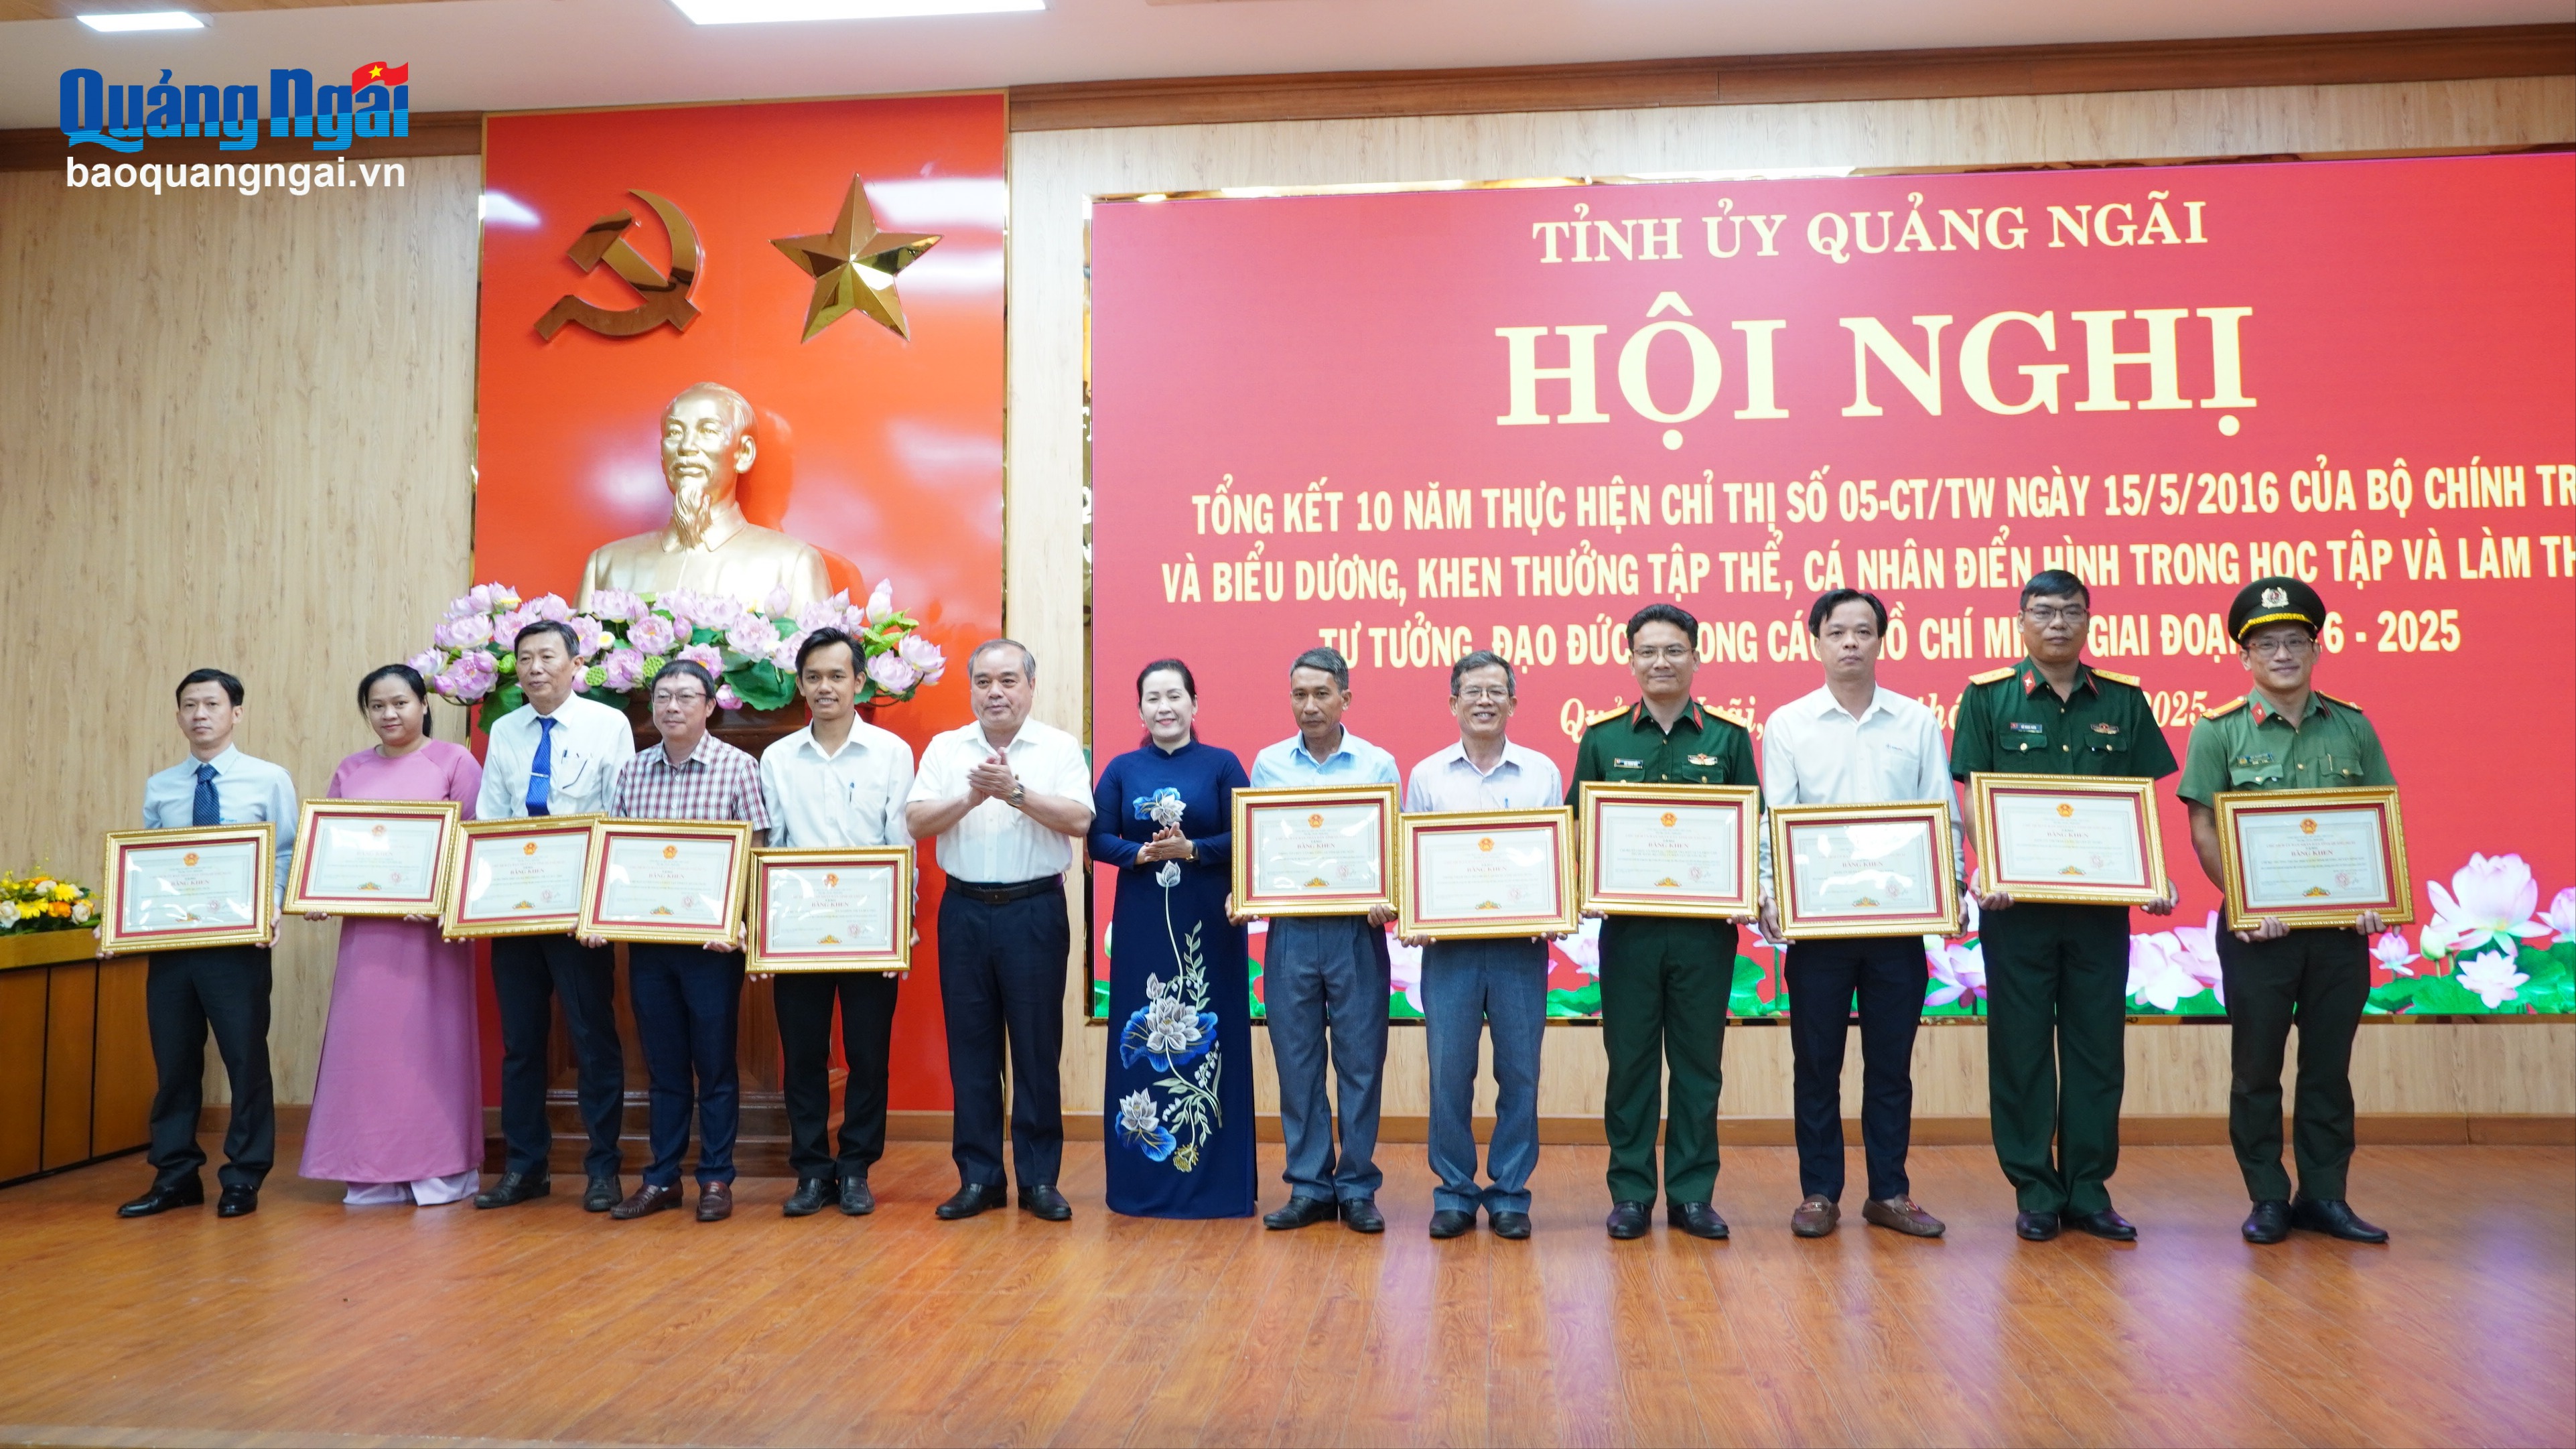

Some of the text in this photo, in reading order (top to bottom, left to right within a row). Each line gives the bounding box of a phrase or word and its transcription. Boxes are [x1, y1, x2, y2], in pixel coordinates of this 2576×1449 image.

[1532, 190, 2208, 264] TỈNH ỦY QUẢNG NGÃI
[1495, 291, 2257, 451] HỘI NGHỊ
[1191, 473, 1274, 535] TỔNG
[1284, 476, 1344, 533] KẾT
[1357, 490, 1393, 532] 10
[1404, 481, 1472, 531] NĂM
[1481, 480, 1566, 536] THỰC
[1576, 475, 1651, 535] HIỆN
[1661, 469, 1714, 526] CHỈ
[1722, 482, 1776, 533] THỊ
[1786, 465, 1830, 523] SỐ
[1838, 477, 1995, 522] 05-CT/TW
[2007, 465, 2090, 518] NGÀY
[2104, 471, 2279, 516] 15/5/2016
[2290, 454, 2357, 512] CỦA
[2366, 458, 2413, 518] BỘ
[2425, 456, 2526, 510] CHÍNH
[1161, 552, 1201, 603] VÀ
[1213, 540, 1284, 602] BIỂU
[1295, 553, 1407, 607] DƯƠNG,
[1418, 557, 1502, 598] KHEN
[1511, 539, 1639, 597] THƯỞNG
[1647, 542, 1710, 602] TẬP
[1718, 529, 1793, 600] THỂ,
[1804, 539, 1846, 592] CÁ
[1857, 538, 1945, 590] NHÂN
[1954, 525, 2032, 589] ĐIỂN
[2129, 542, 2240, 585] TRONG
[2326, 529, 2392, 590] TẬP
[2402, 527, 2447, 580] VÀ
[2458, 527, 2530, 579] LÀM
[1489, 624, 1557, 674] ĐẠO
[1697, 620, 1758, 664] ONG
[1767, 610, 1822, 663] CÁ
[1877, 601, 1908, 661] Ồ
[1919, 606, 1973, 660] CHÍ
[1984, 616, 2029, 659] MI
[2087, 614, 2150, 657] GIAI
[2160, 613, 2237, 663] ĐOẠ
[2377, 609, 2461, 652] 2025
